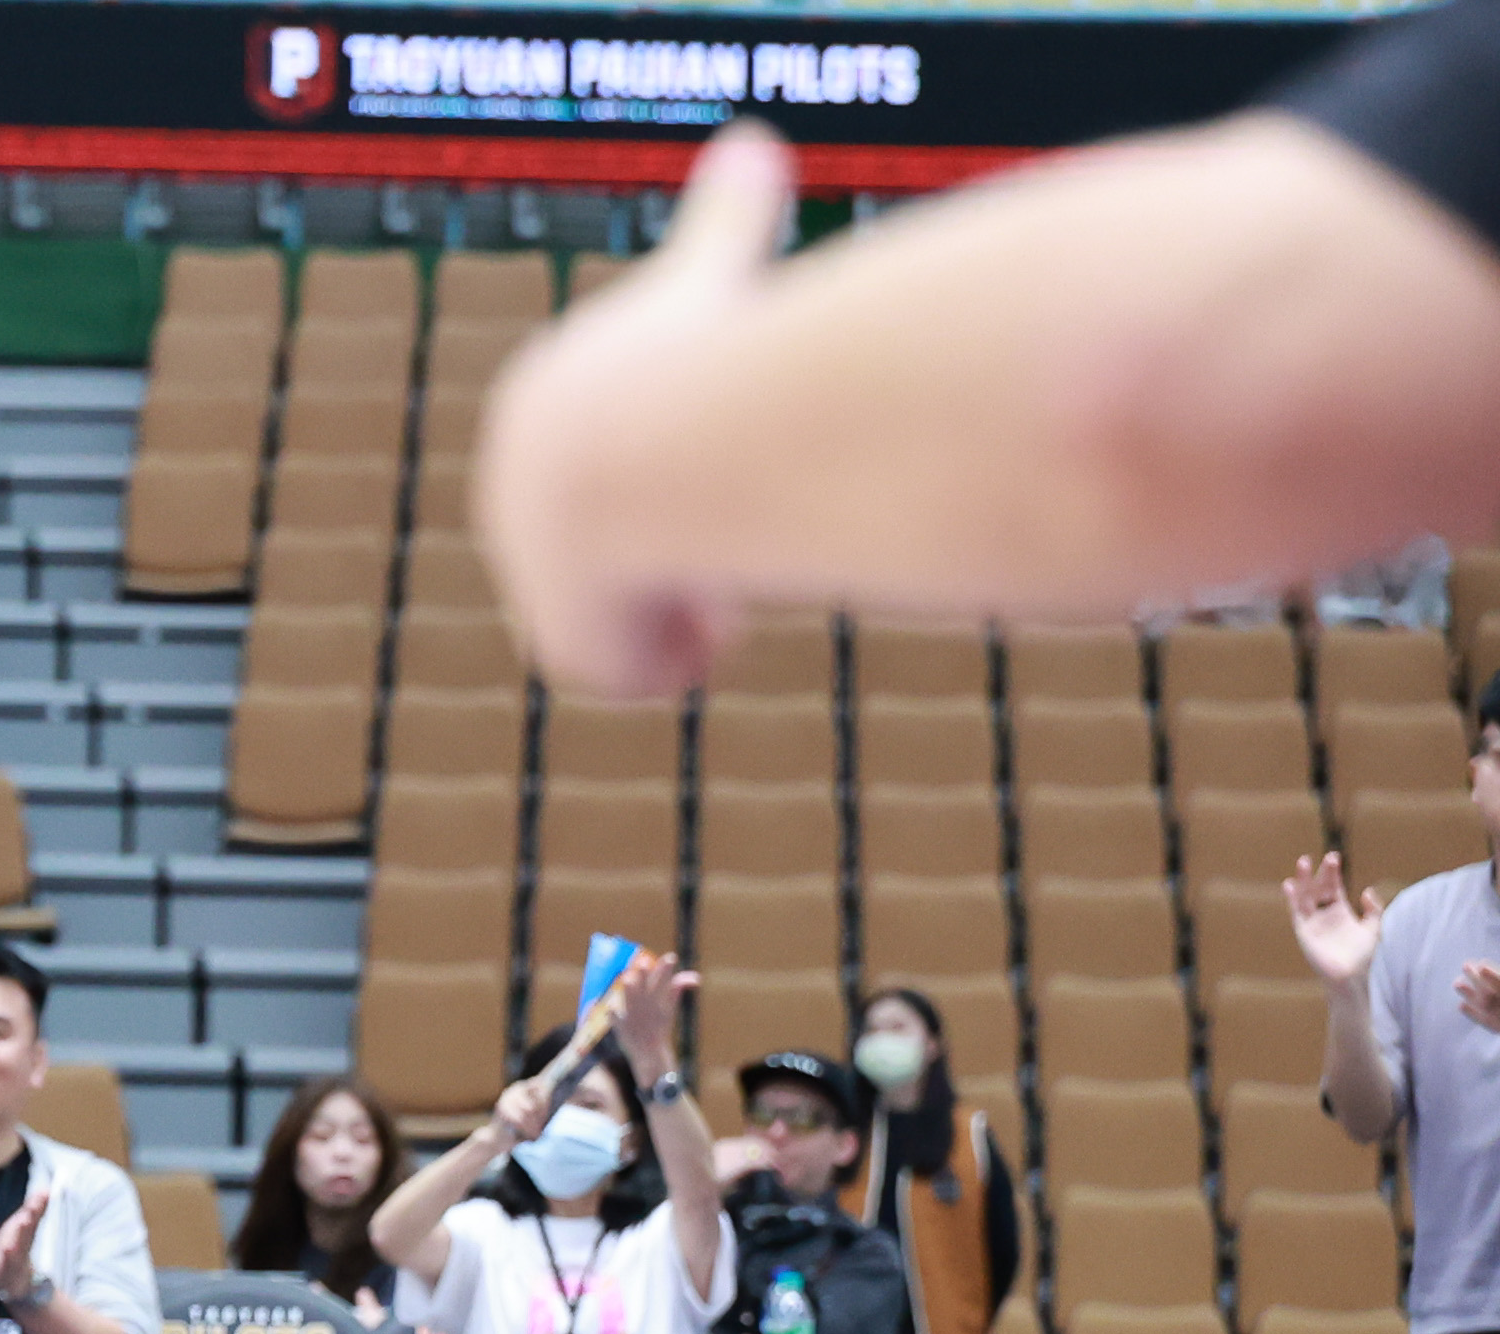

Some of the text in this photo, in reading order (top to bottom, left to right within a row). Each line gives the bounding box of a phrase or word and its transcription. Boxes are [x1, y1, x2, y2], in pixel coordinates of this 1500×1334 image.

[270, 26, 320, 99] P
[342, 33, 567, 98] TAOYUAN
[752, 43, 921, 105] PILOTS
